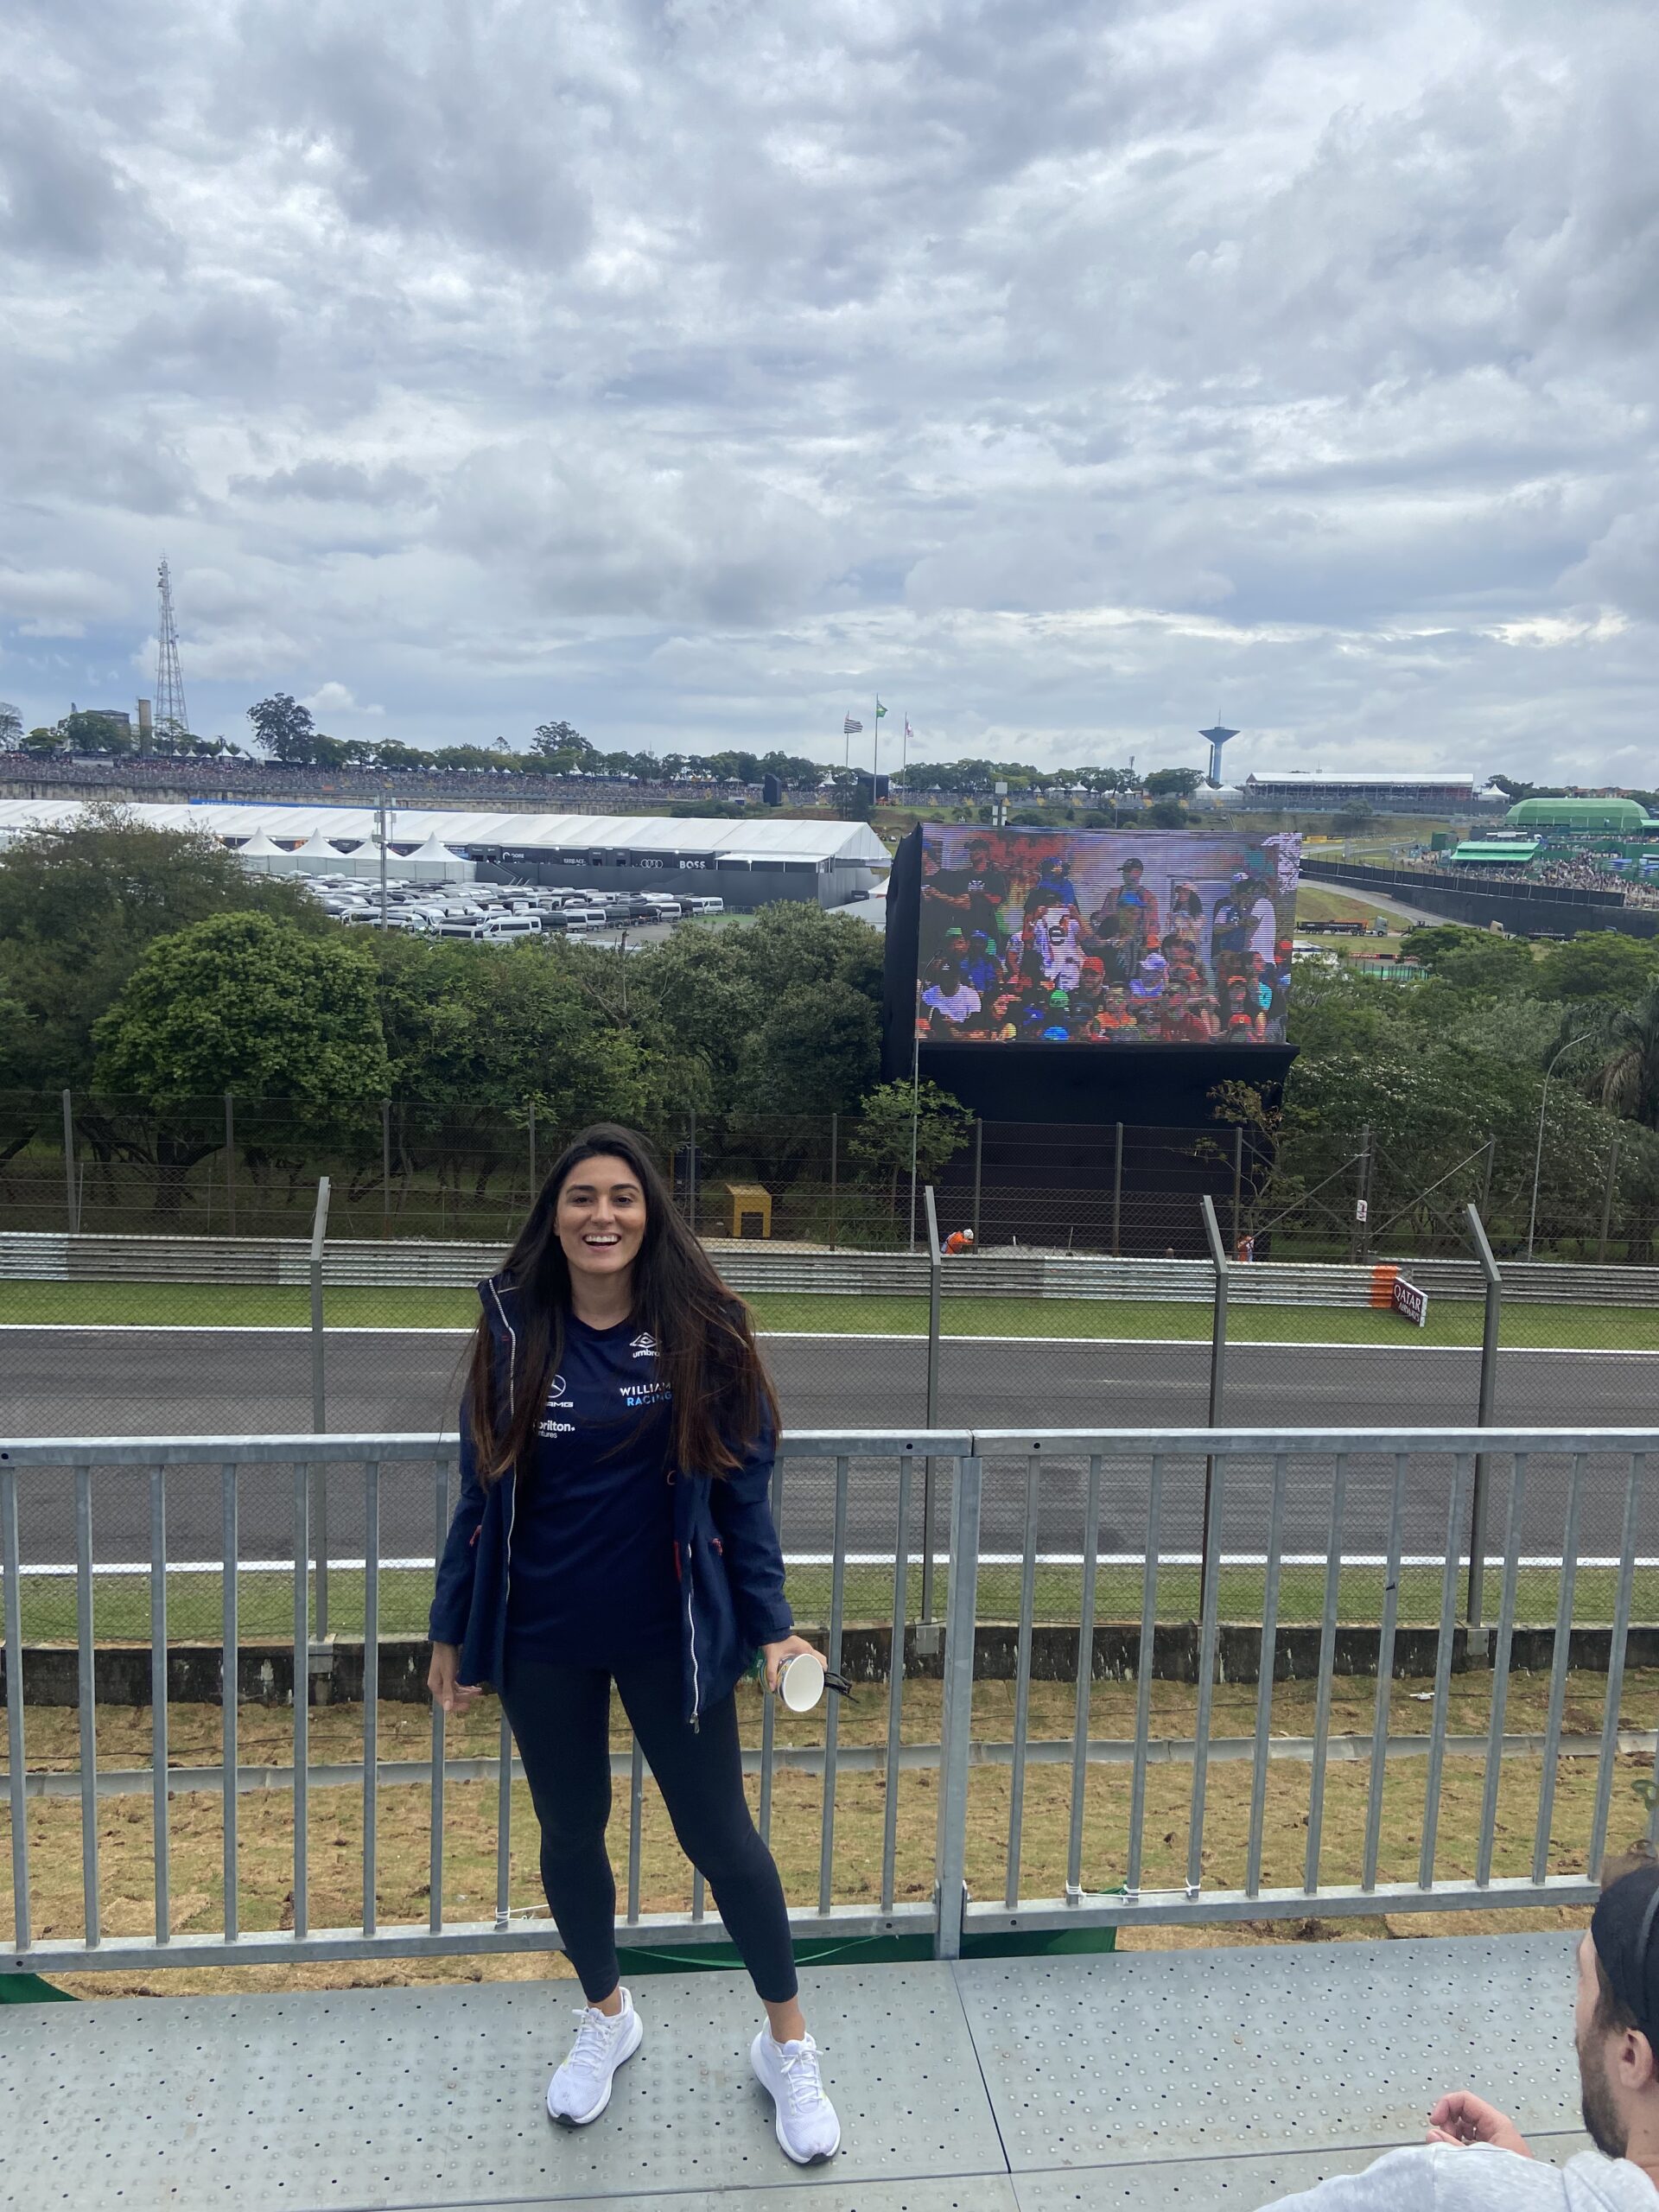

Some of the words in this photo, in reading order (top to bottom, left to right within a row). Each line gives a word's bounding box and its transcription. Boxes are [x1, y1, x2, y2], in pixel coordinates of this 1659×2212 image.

[679, 860, 706, 869] BOSS
[1394, 1284, 1421, 1313] QATAR
[620, 1382, 671, 1396] WILLIAM
[626, 1391, 672, 1407] RACING
